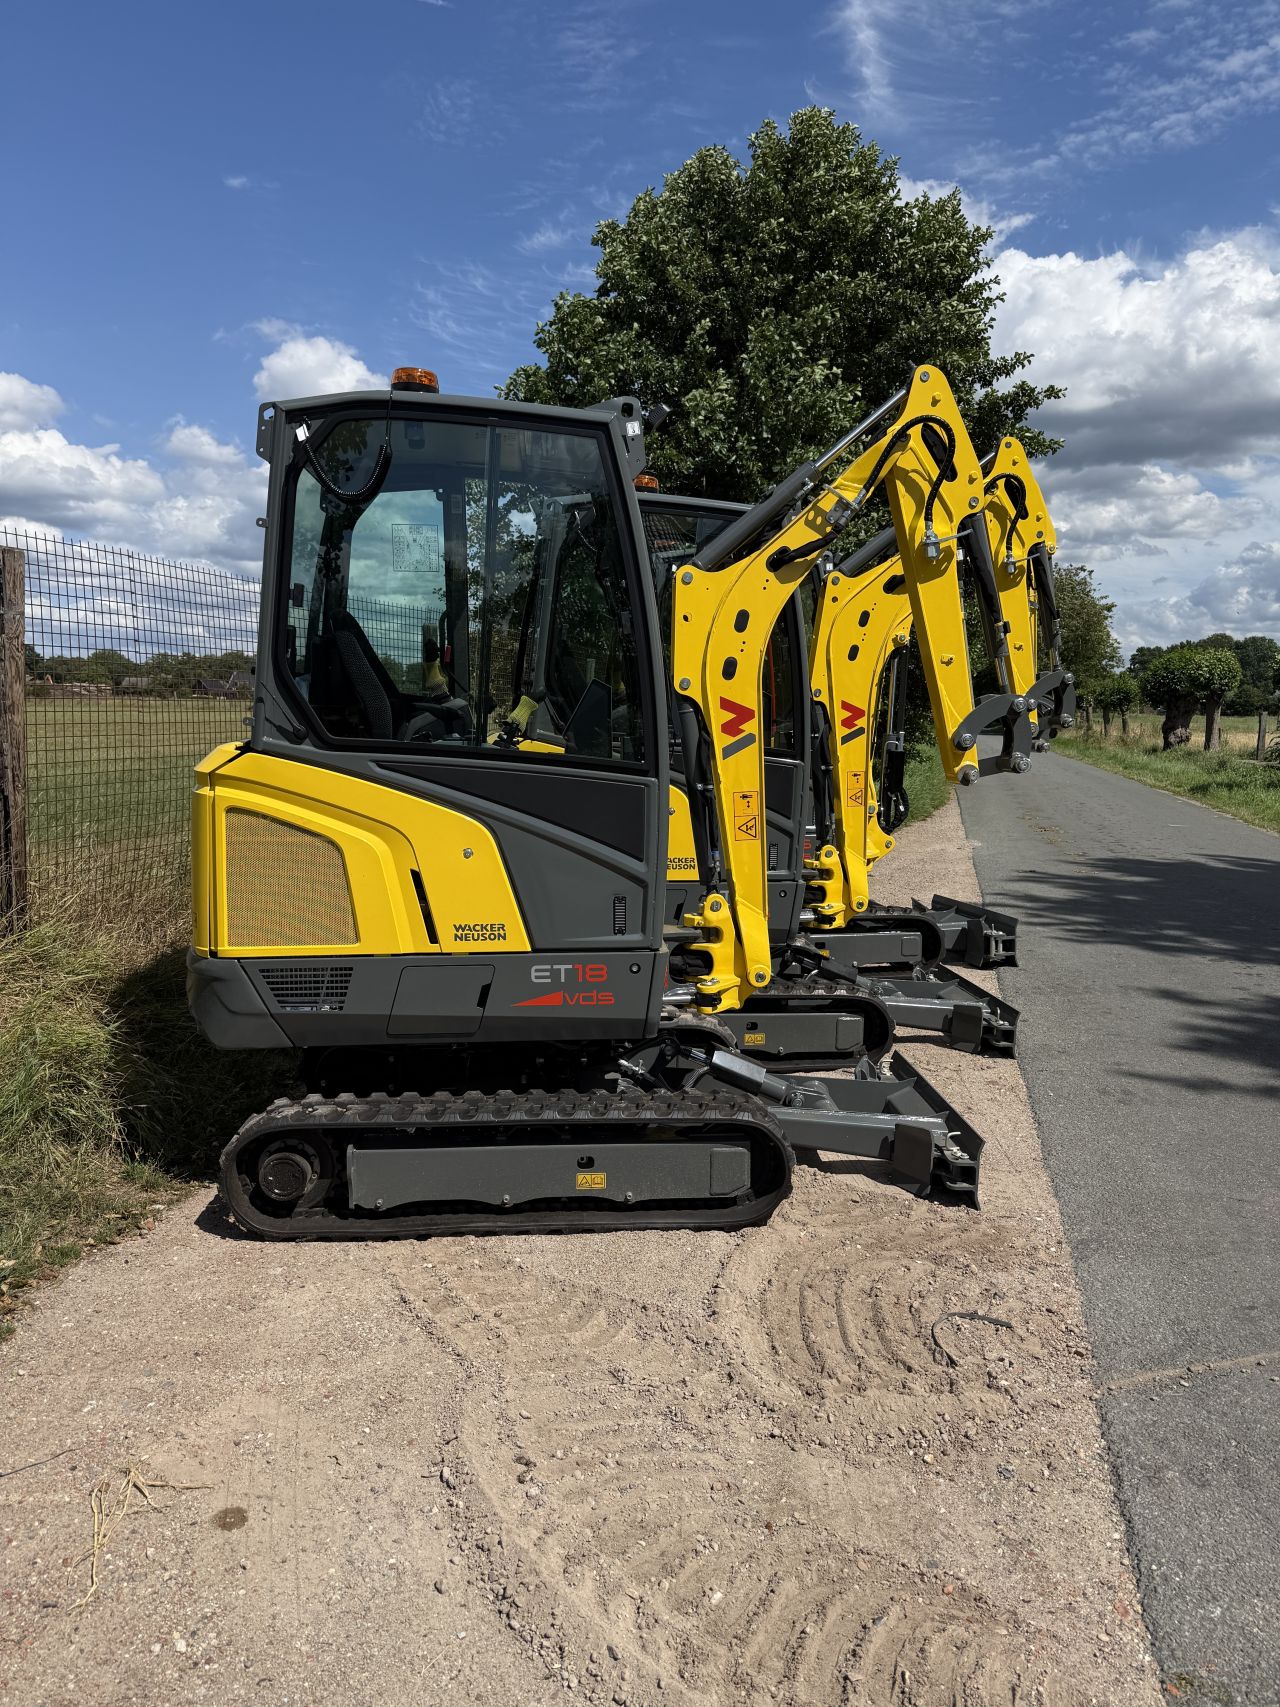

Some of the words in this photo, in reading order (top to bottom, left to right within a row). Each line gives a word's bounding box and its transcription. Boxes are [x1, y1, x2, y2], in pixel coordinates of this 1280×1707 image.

[453, 923, 506, 933] WACKER
[454, 932, 507, 942] NEUSON
[530, 964, 608, 983] ET18
[564, 990, 615, 1006] vds
